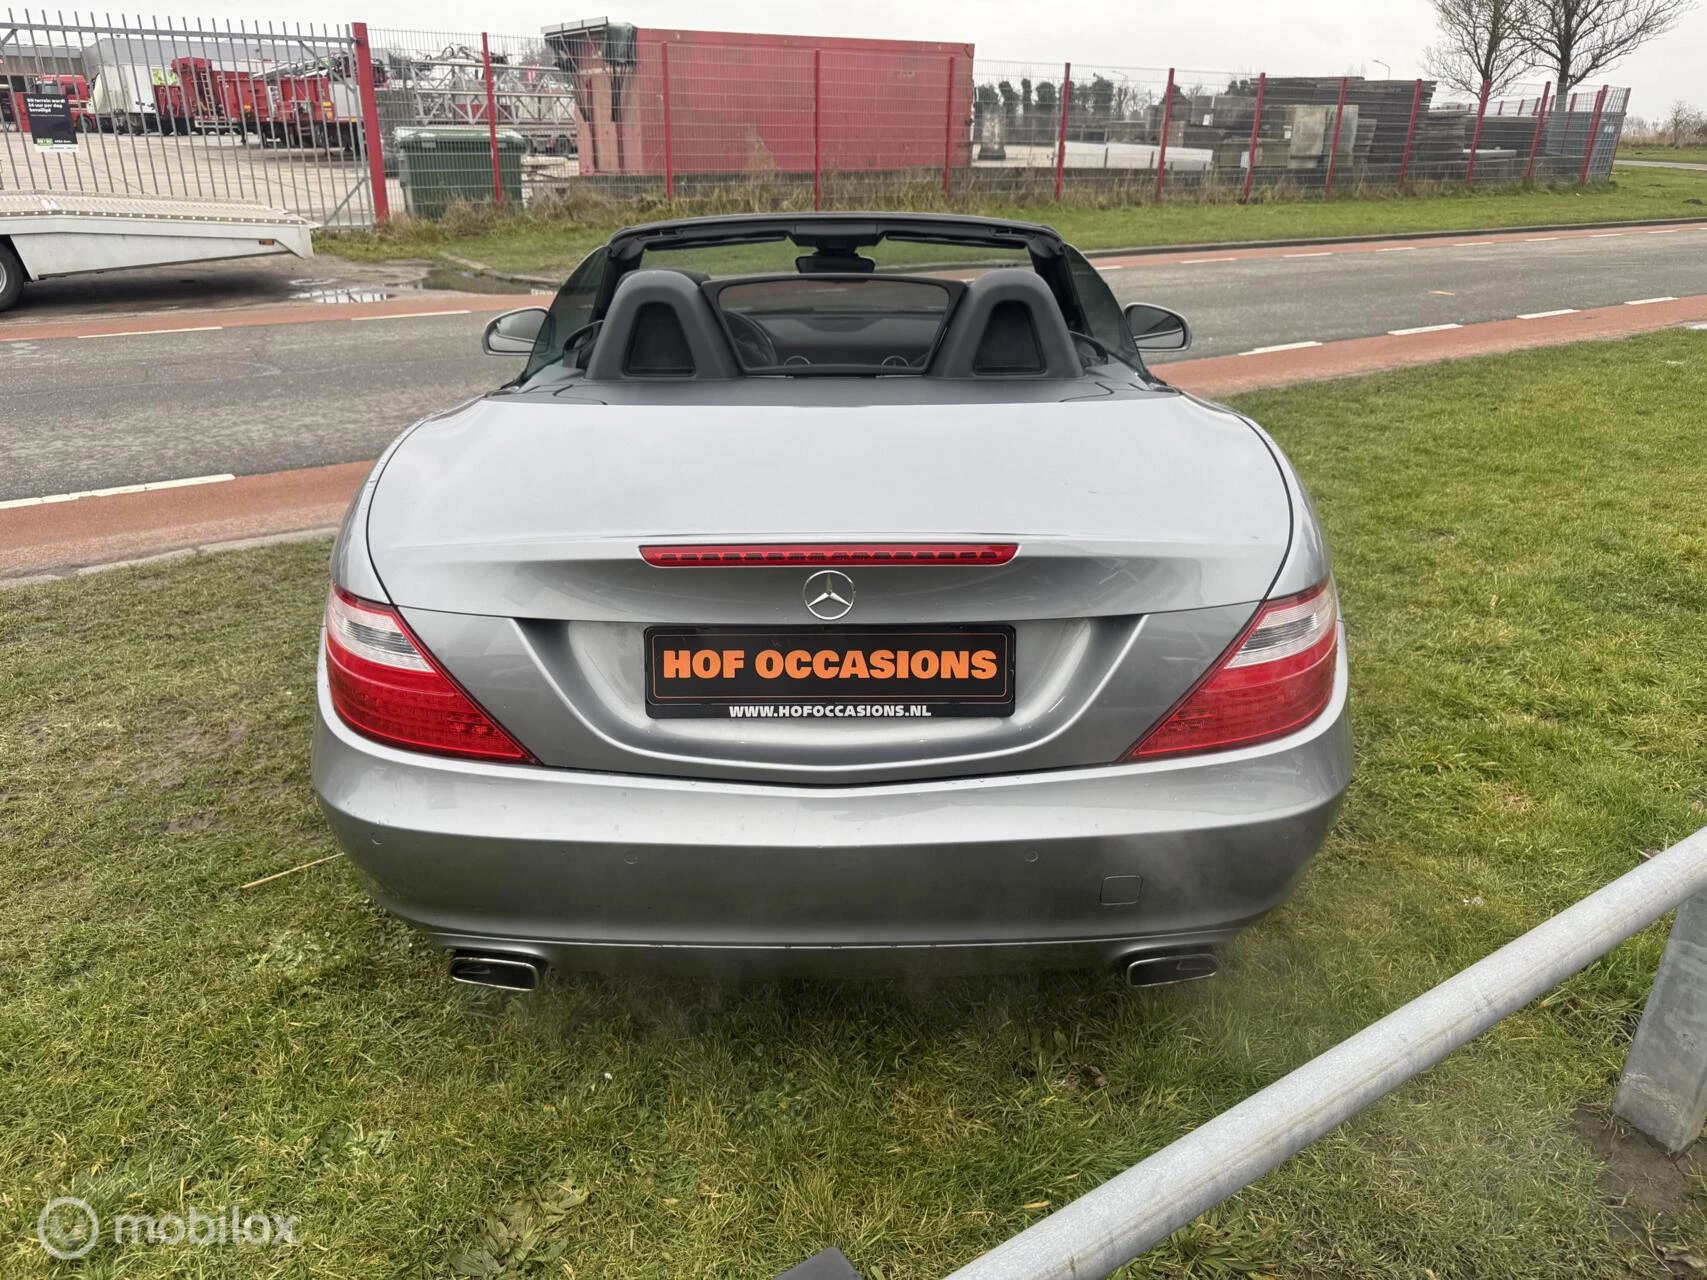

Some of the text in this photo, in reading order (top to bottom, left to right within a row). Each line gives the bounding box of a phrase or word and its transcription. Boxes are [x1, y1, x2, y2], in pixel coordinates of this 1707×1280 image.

[663, 649, 998, 680] HOF OCCASIONS
[728, 704, 932, 718] WWW.HOFOCCASIONS.NL
